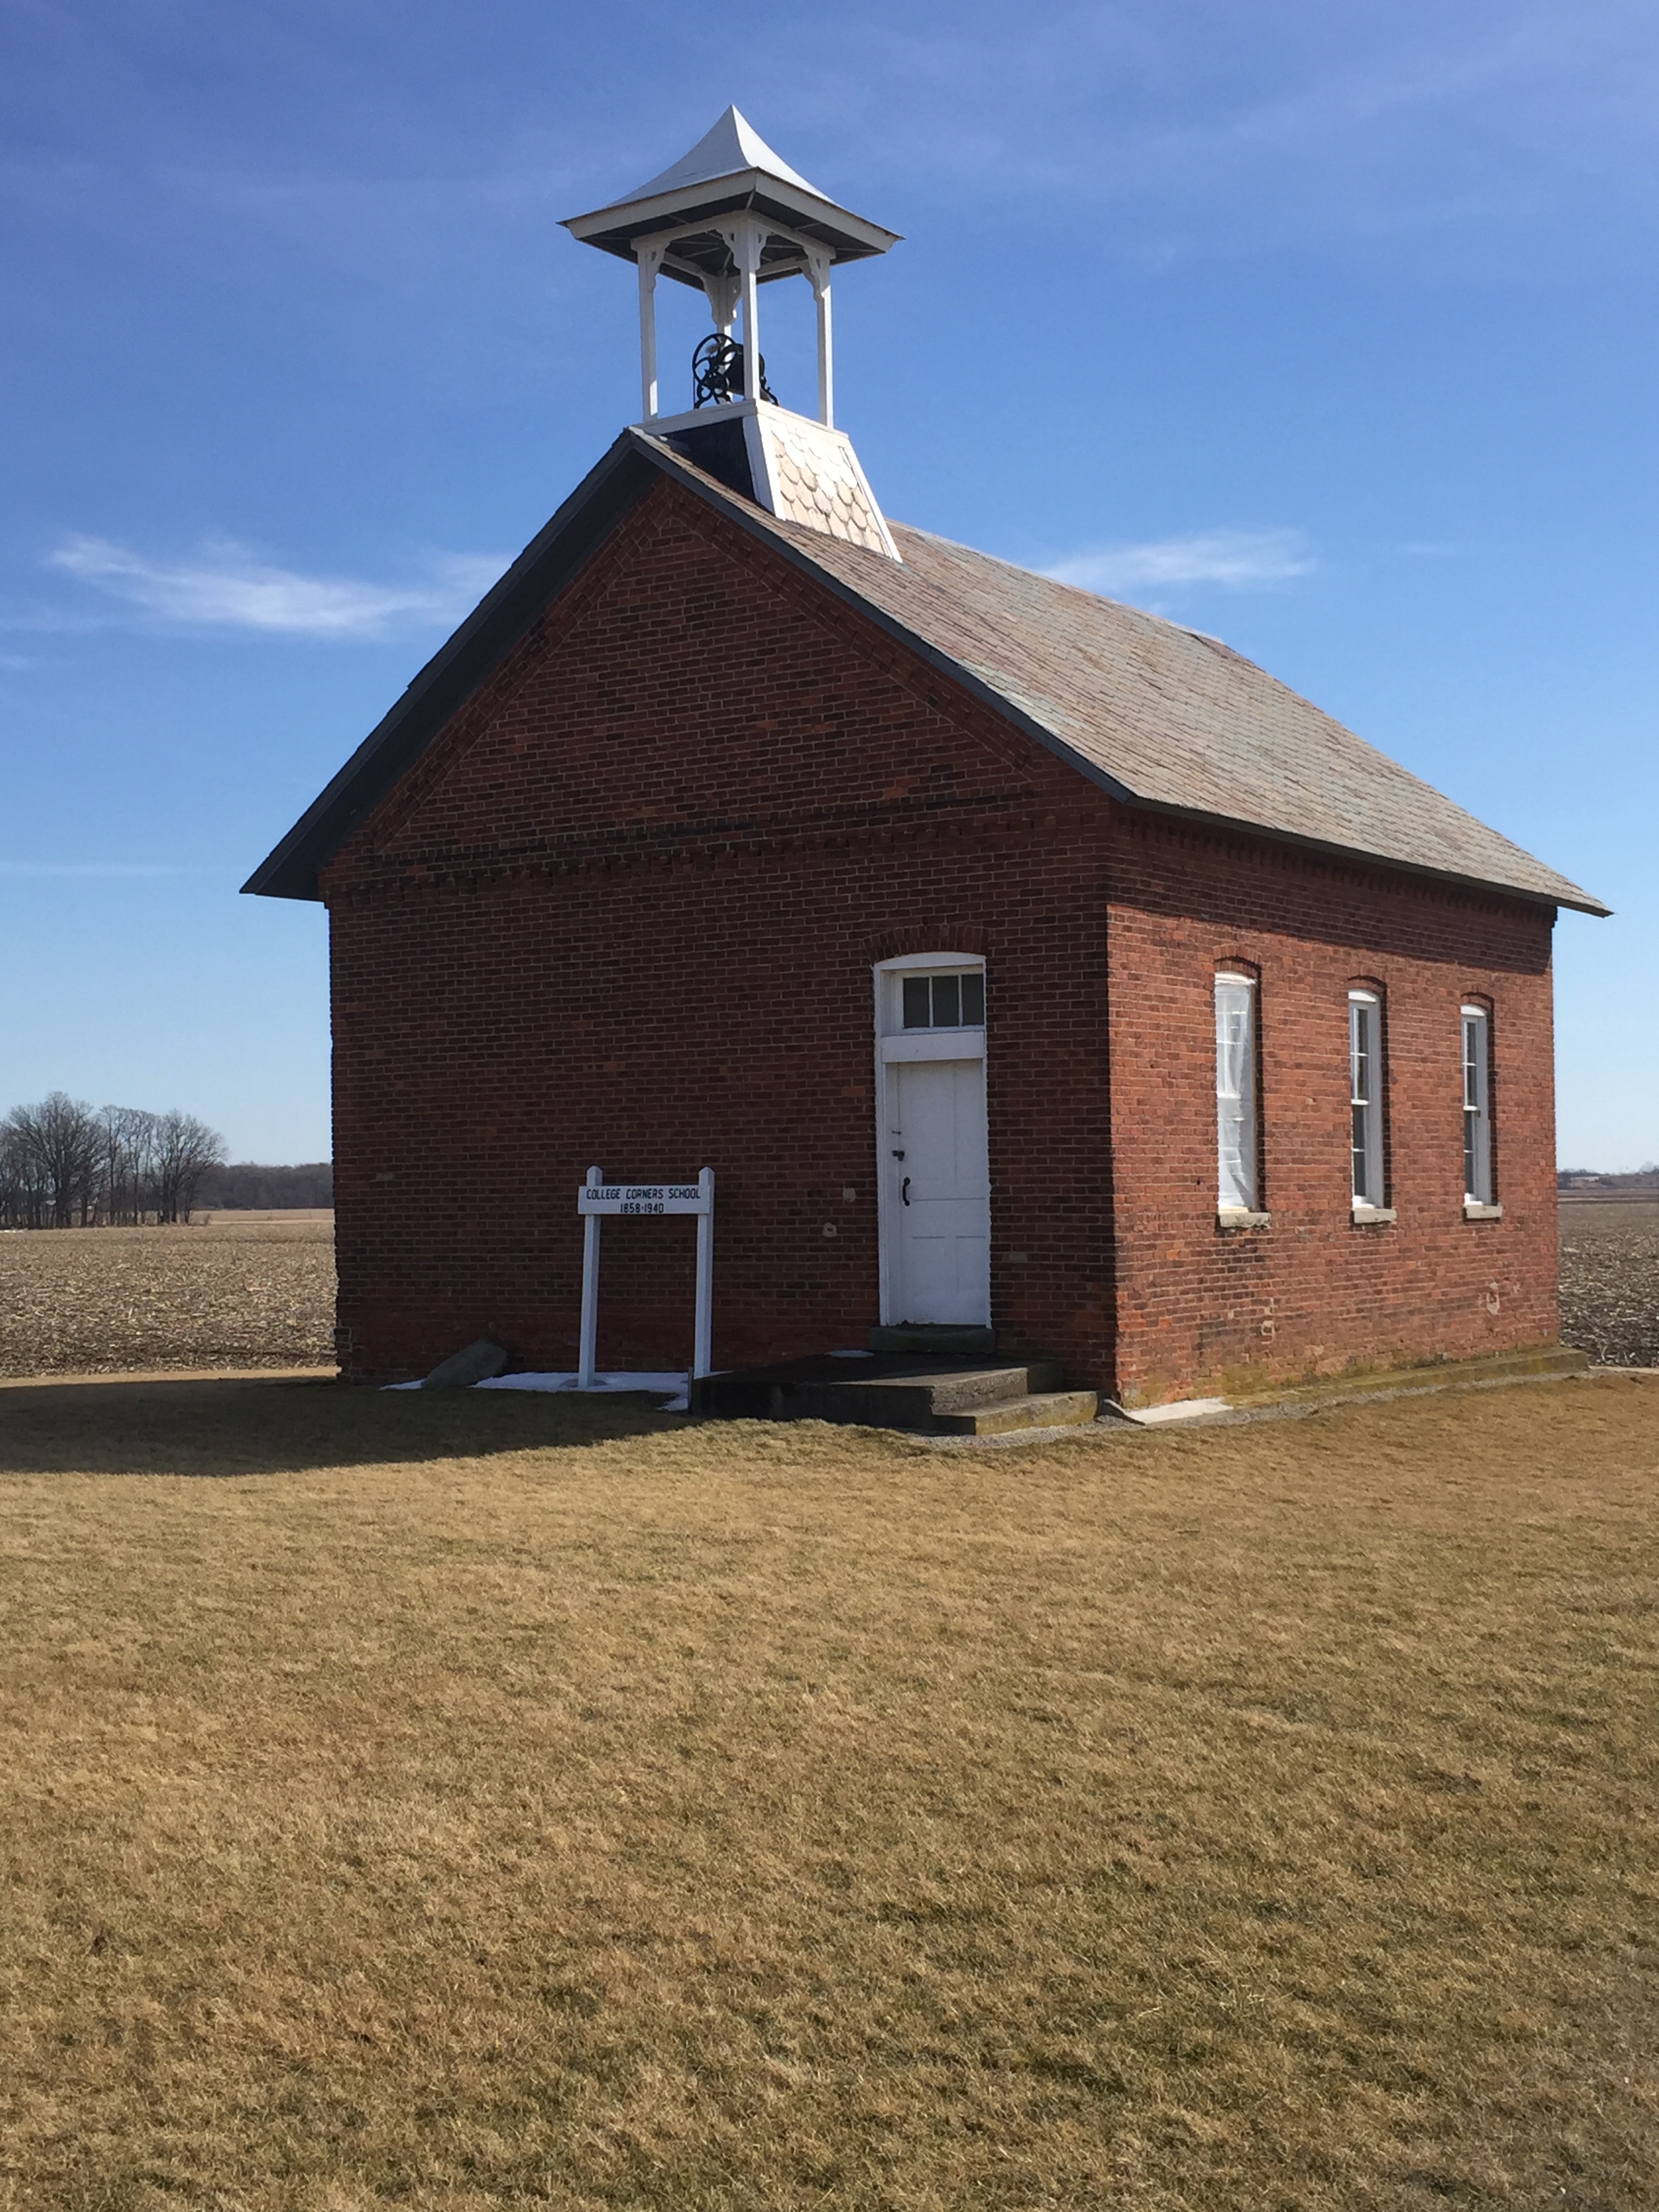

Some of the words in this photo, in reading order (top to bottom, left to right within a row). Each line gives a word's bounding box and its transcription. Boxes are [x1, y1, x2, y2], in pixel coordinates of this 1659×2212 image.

[586, 1188, 621, 1200] COLLEGE
[626, 1188, 663, 1200] CORNERS
[668, 1188, 701, 1199] SCHOOL
